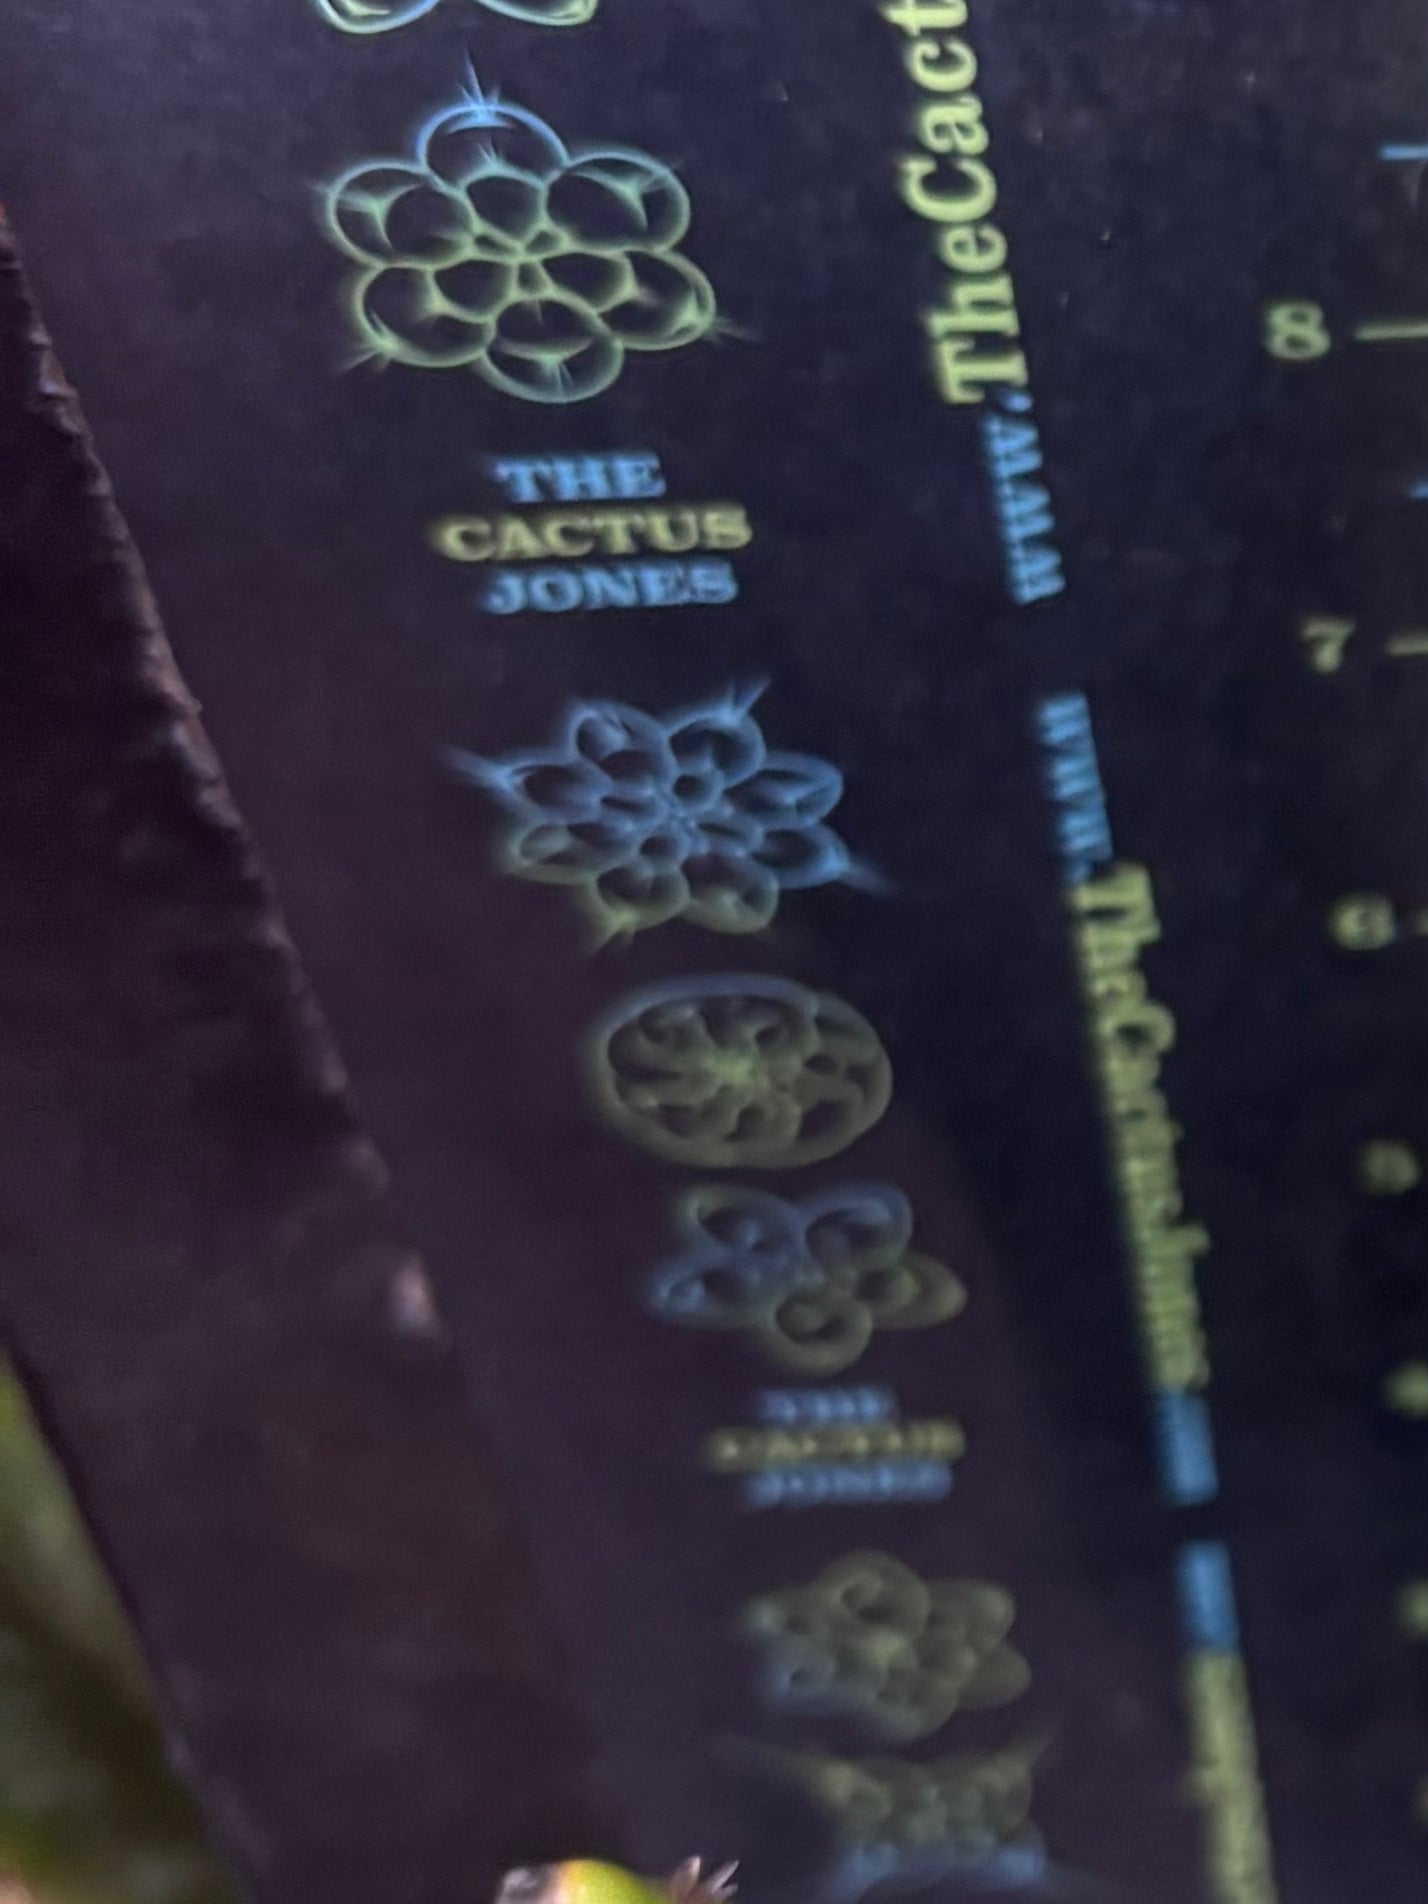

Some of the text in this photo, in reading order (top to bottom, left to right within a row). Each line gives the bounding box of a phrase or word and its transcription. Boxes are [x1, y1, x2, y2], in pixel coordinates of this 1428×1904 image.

[1266, 300, 1331, 361] 8
[490, 449, 667, 503] THE
[432, 502, 753, 562] CACTUS
[482, 558, 738, 615] JONES
[1299, 615, 1356, 673] 7
